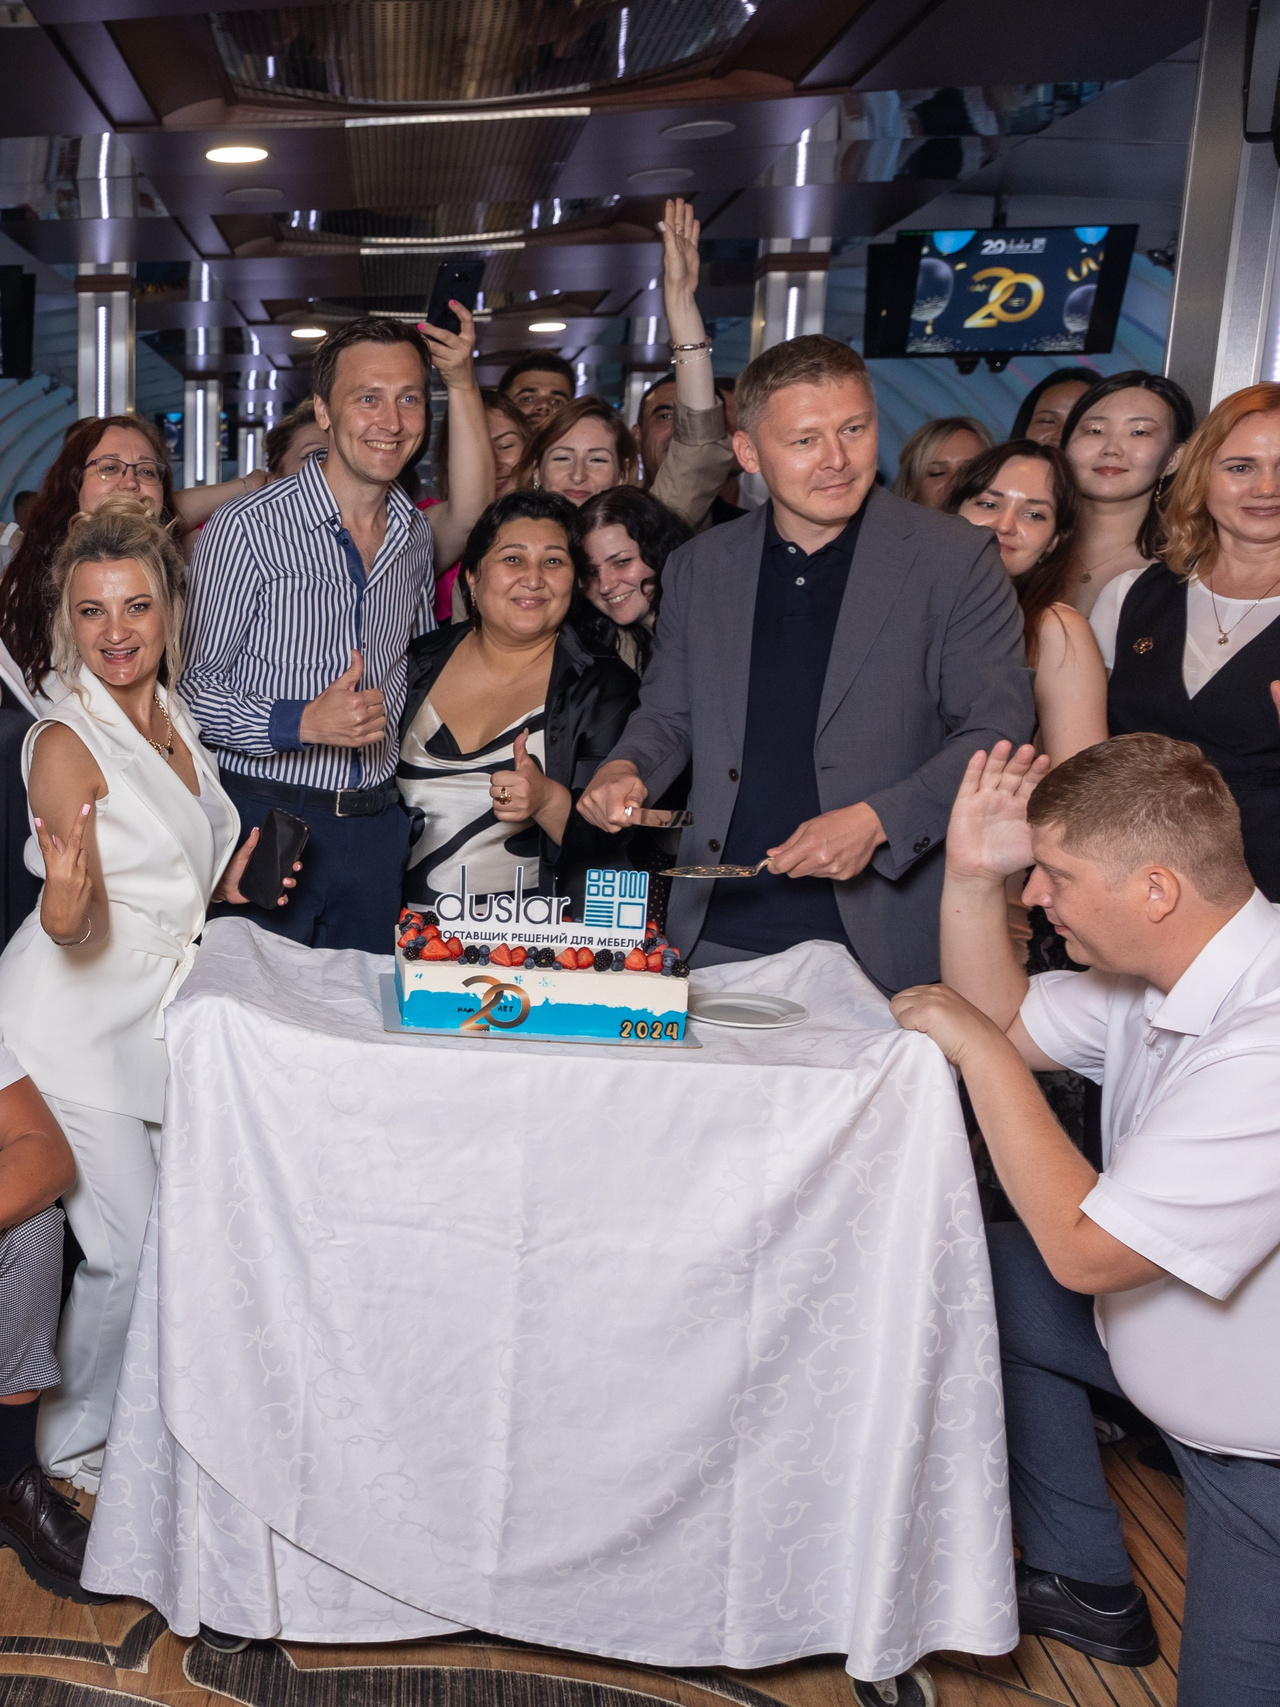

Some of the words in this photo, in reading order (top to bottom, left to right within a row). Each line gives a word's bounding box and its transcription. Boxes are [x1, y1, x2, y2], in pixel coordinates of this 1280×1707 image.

[963, 266, 1045, 328] 20
[436, 864, 570, 925] duslar
[511, 932, 568, 945] РЕШЕНИЙ
[570, 935, 594, 946] ДЛЯ
[461, 975, 531, 1032] 20
[619, 1019, 679, 1040] 2024
